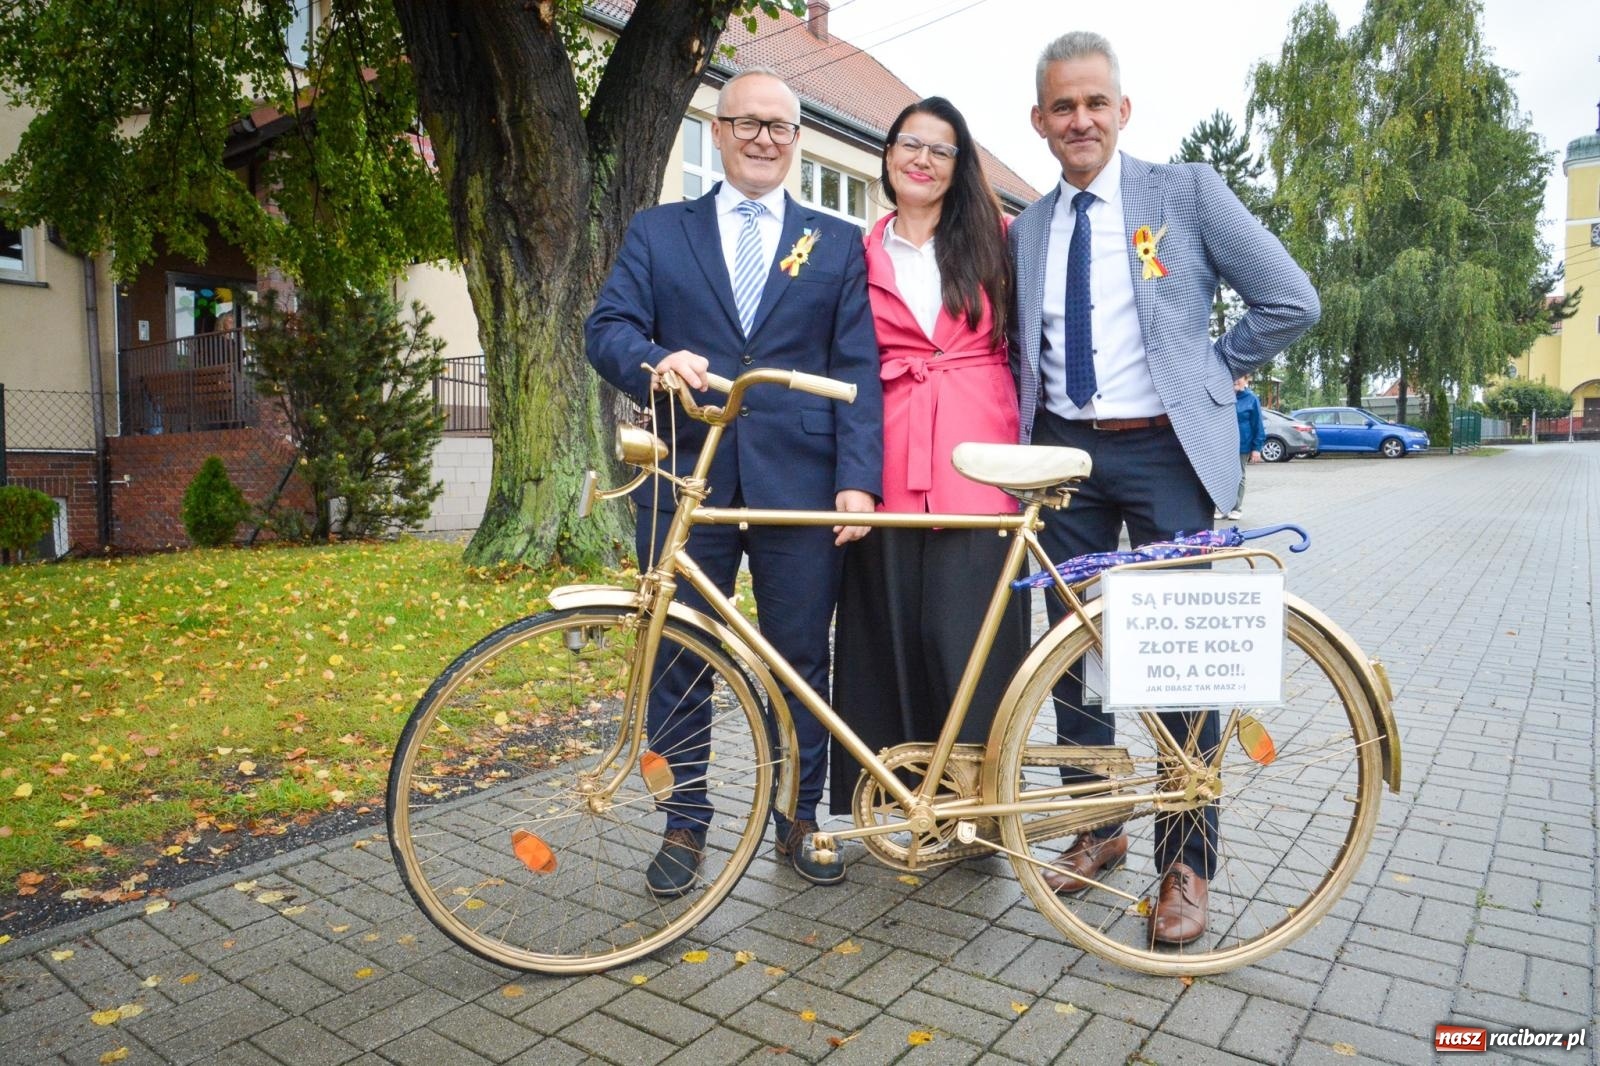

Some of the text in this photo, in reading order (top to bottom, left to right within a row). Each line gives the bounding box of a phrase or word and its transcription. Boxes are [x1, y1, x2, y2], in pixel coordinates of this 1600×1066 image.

[1131, 592, 1261, 609] SĄ FUNDUSZE
[1126, 615, 1267, 630] K.P.O. SZOŁTYS
[1138, 639, 1254, 654] ZŁOTE KOŁO
[1147, 665, 1181, 680] MO,
[1186, 665, 1199, 678] A
[1146, 685, 1162, 693] JAK
